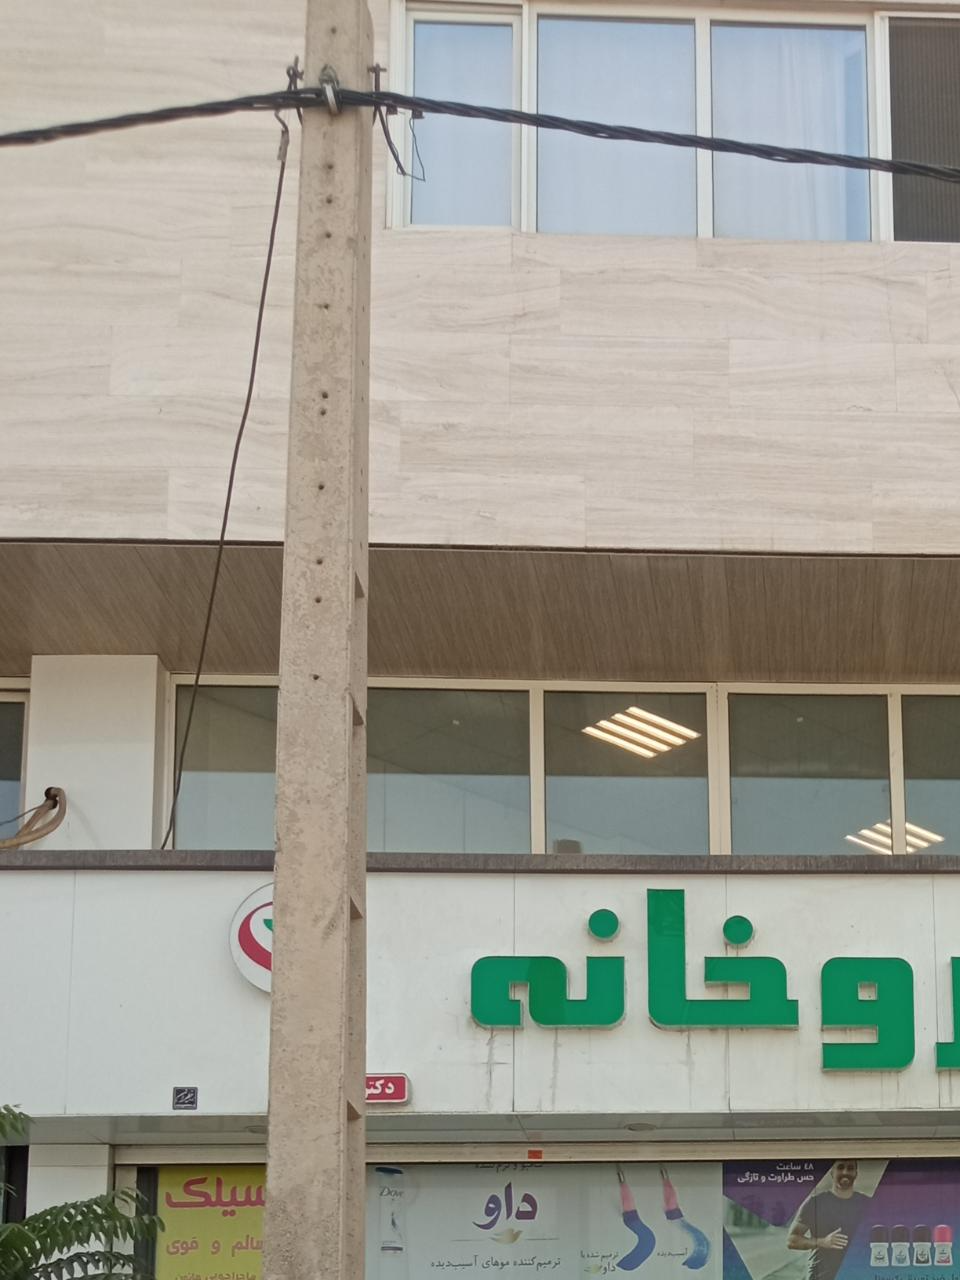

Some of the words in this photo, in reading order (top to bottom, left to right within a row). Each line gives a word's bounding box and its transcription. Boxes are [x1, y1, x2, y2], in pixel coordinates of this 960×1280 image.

[776, 1162, 802, 1171] ساعت
[736, 1171, 760, 1184] تازگی
[767, 1172, 796, 1184] طراوت
[797, 1174, 815, 1184] حس
[472, 1181, 539, 1230] داو
[481, 1256, 510, 1269] موهای
